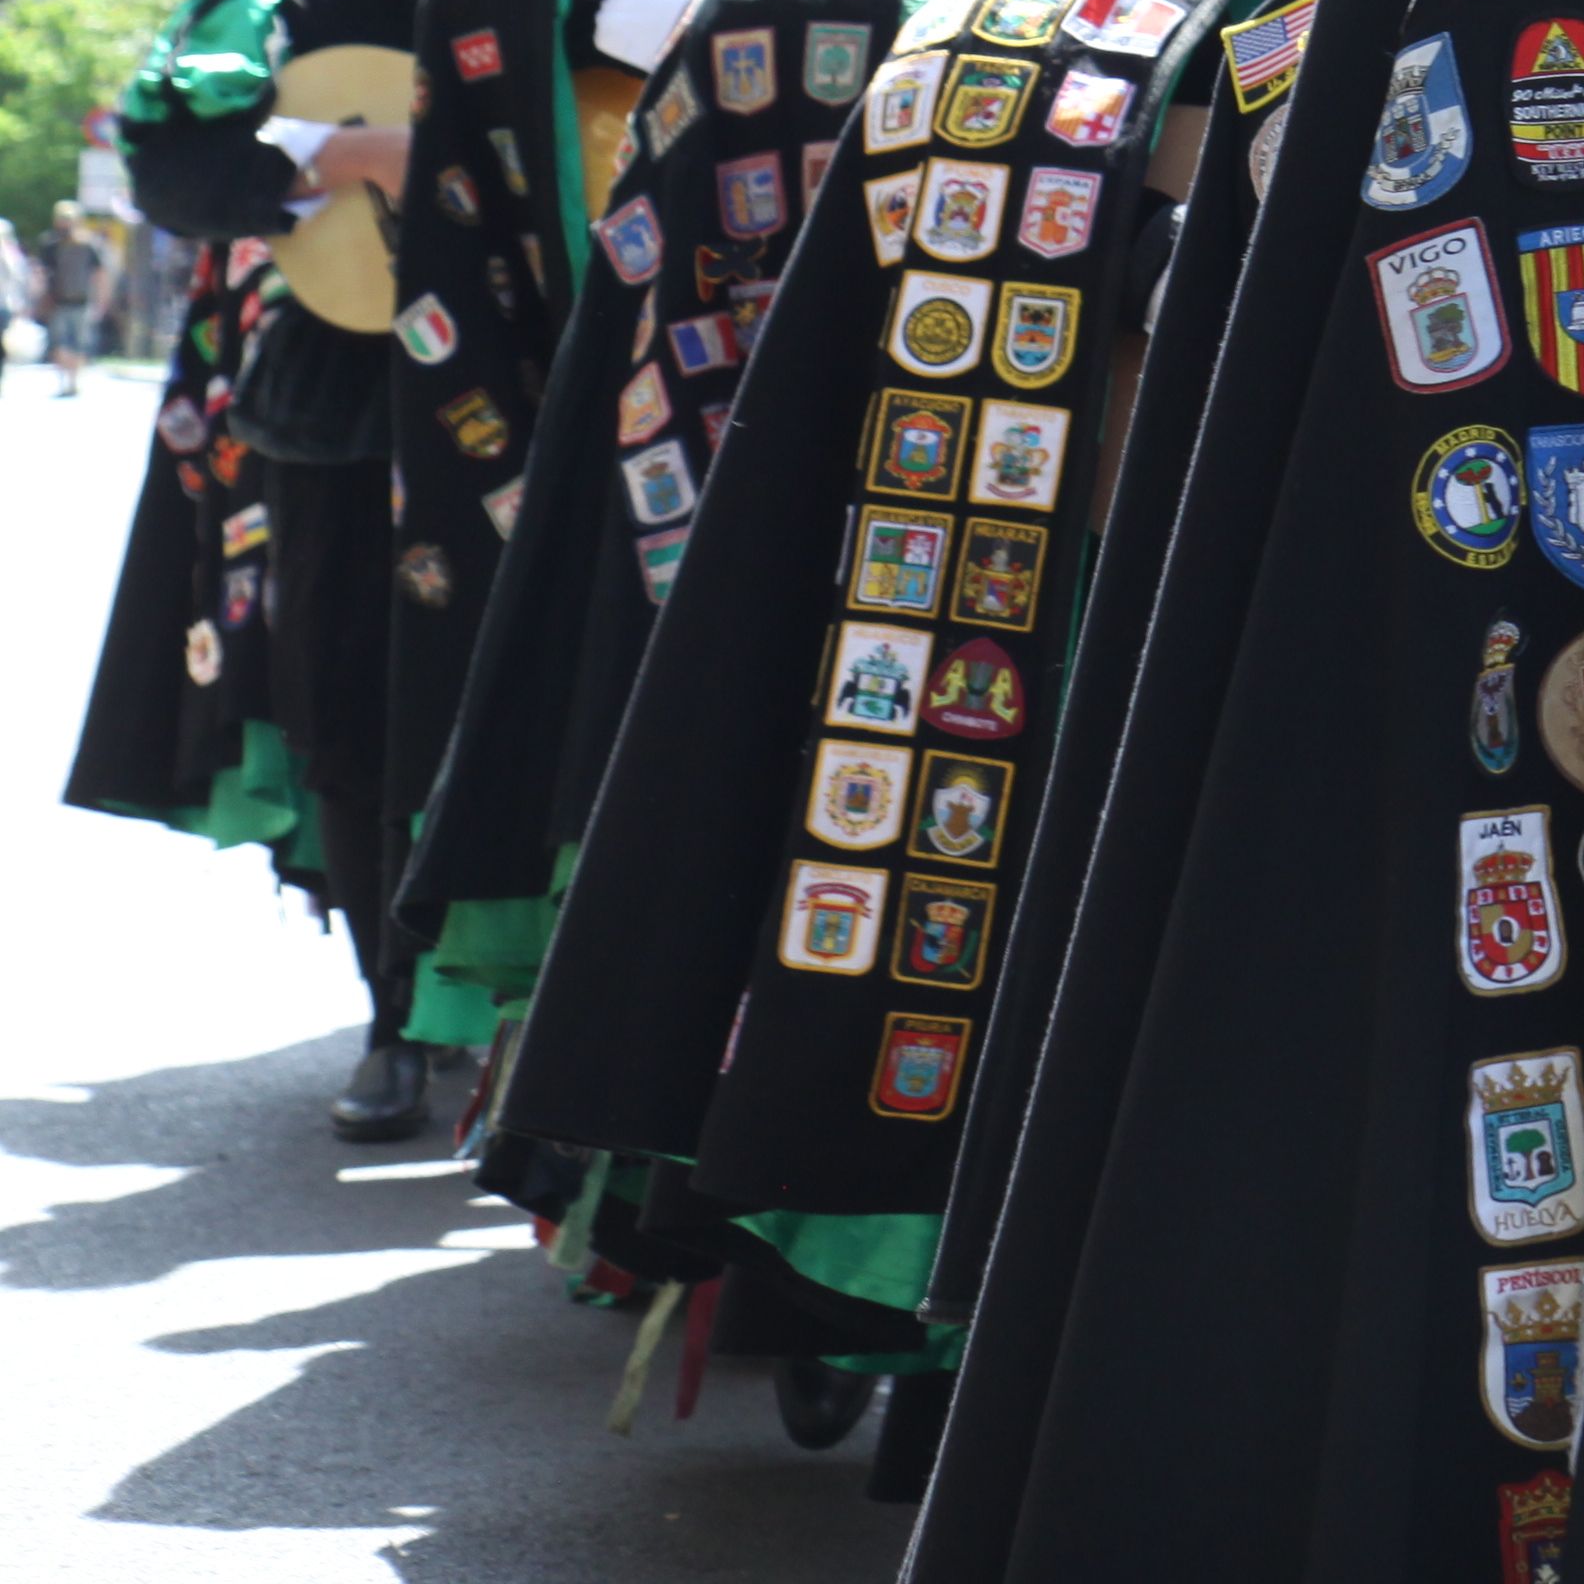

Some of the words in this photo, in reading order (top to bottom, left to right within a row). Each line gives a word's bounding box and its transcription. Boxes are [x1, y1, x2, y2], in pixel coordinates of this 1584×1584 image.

[1512, 89, 1533, 102] 90
[1544, 124, 1584, 139] POINT
[1388, 236, 1468, 276] VIGO
[1434, 426, 1497, 456] MADRID
[1478, 816, 1523, 838] JAÉN
[1494, 1200, 1582, 1235] HUELVA
